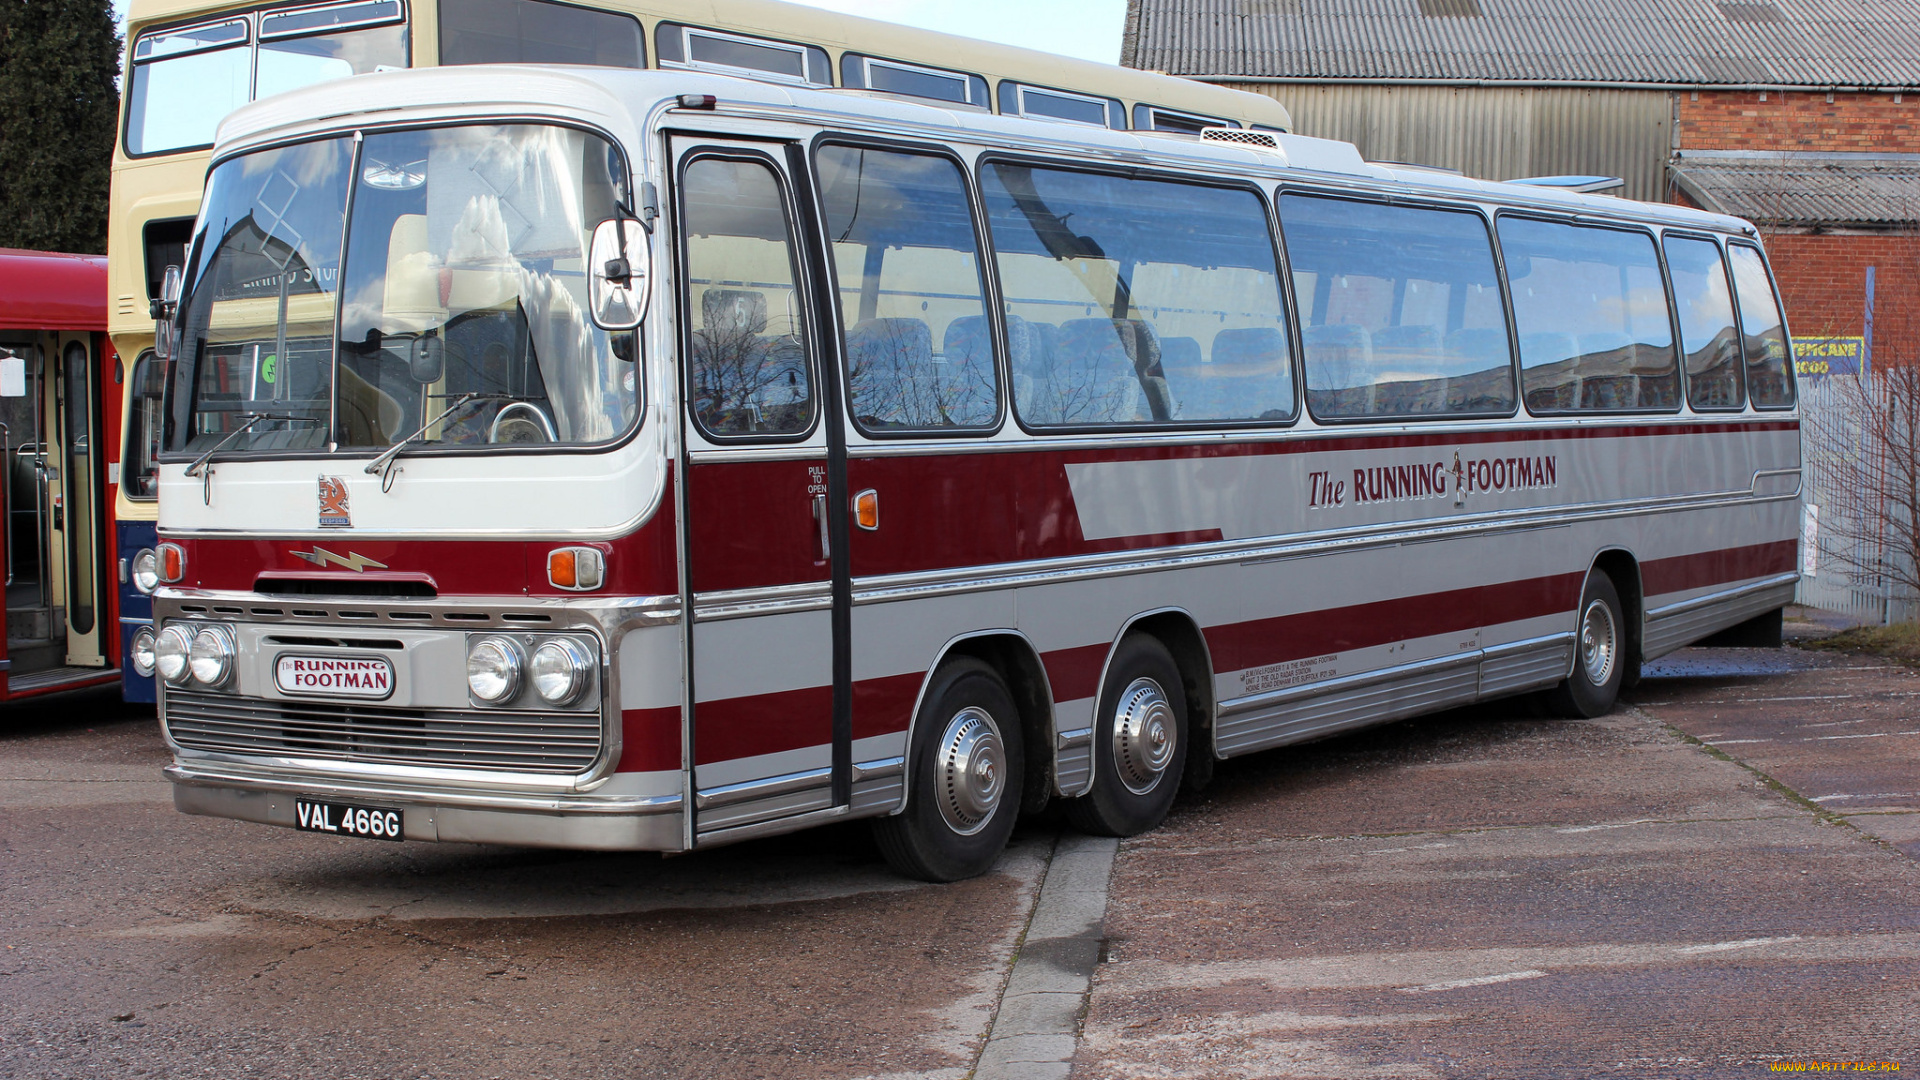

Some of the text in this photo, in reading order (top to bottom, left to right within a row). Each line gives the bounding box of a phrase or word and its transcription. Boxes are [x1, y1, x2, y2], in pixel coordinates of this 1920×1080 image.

[808, 466, 826, 476] PULL
[812, 475, 822, 484] TO
[1308, 455, 1558, 508] The RUNNING FOOTMAN
[807, 484, 827, 494] OPEN
[281, 660, 386, 671] The RUNNING
[295, 672, 388, 689] FOOTMAN
[297, 802, 400, 838] VAL 466G
